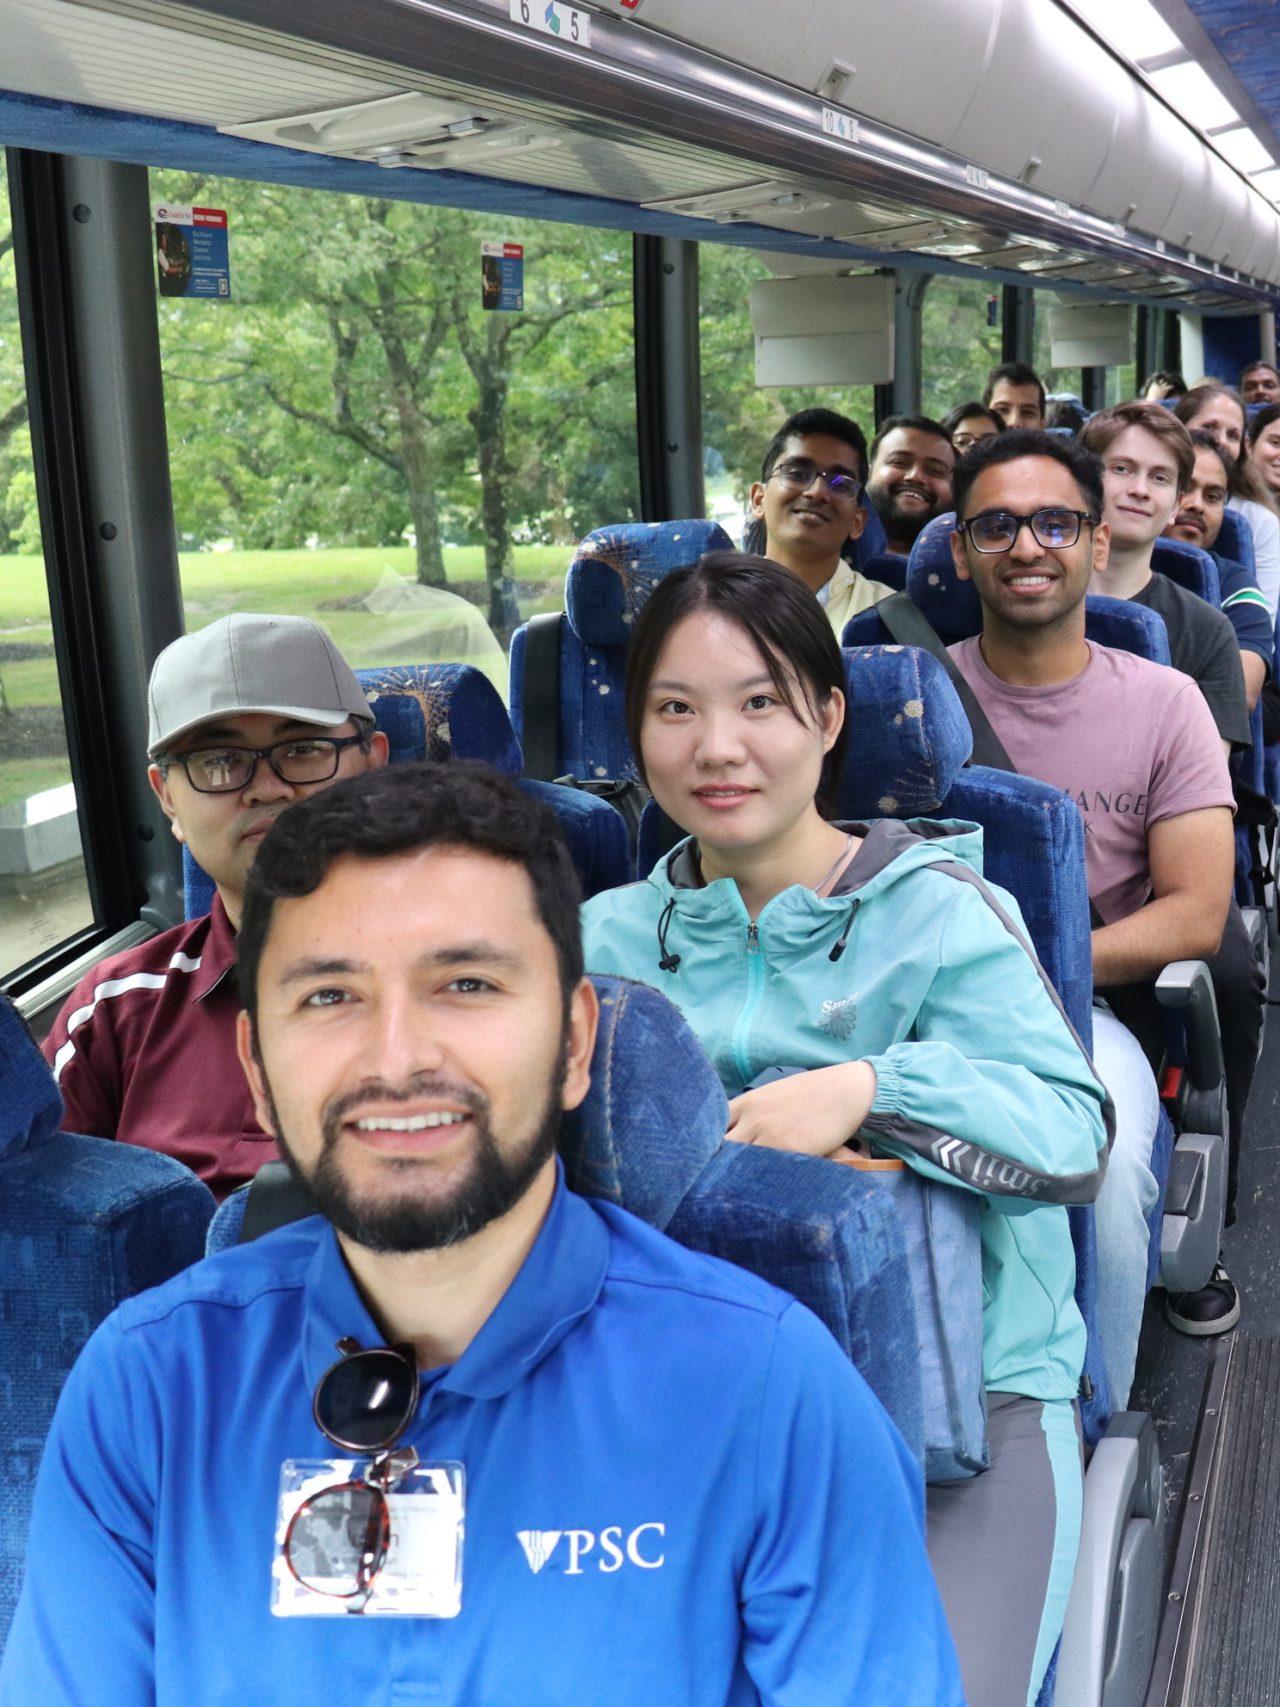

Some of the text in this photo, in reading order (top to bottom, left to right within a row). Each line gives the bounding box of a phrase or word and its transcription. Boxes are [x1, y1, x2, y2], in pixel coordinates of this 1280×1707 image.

[520, 0, 579, 42] 6 5
[825, 111, 834, 133] 10
[1065, 788, 1149, 816] ANGE
[562, 1522, 666, 1575] PSC
